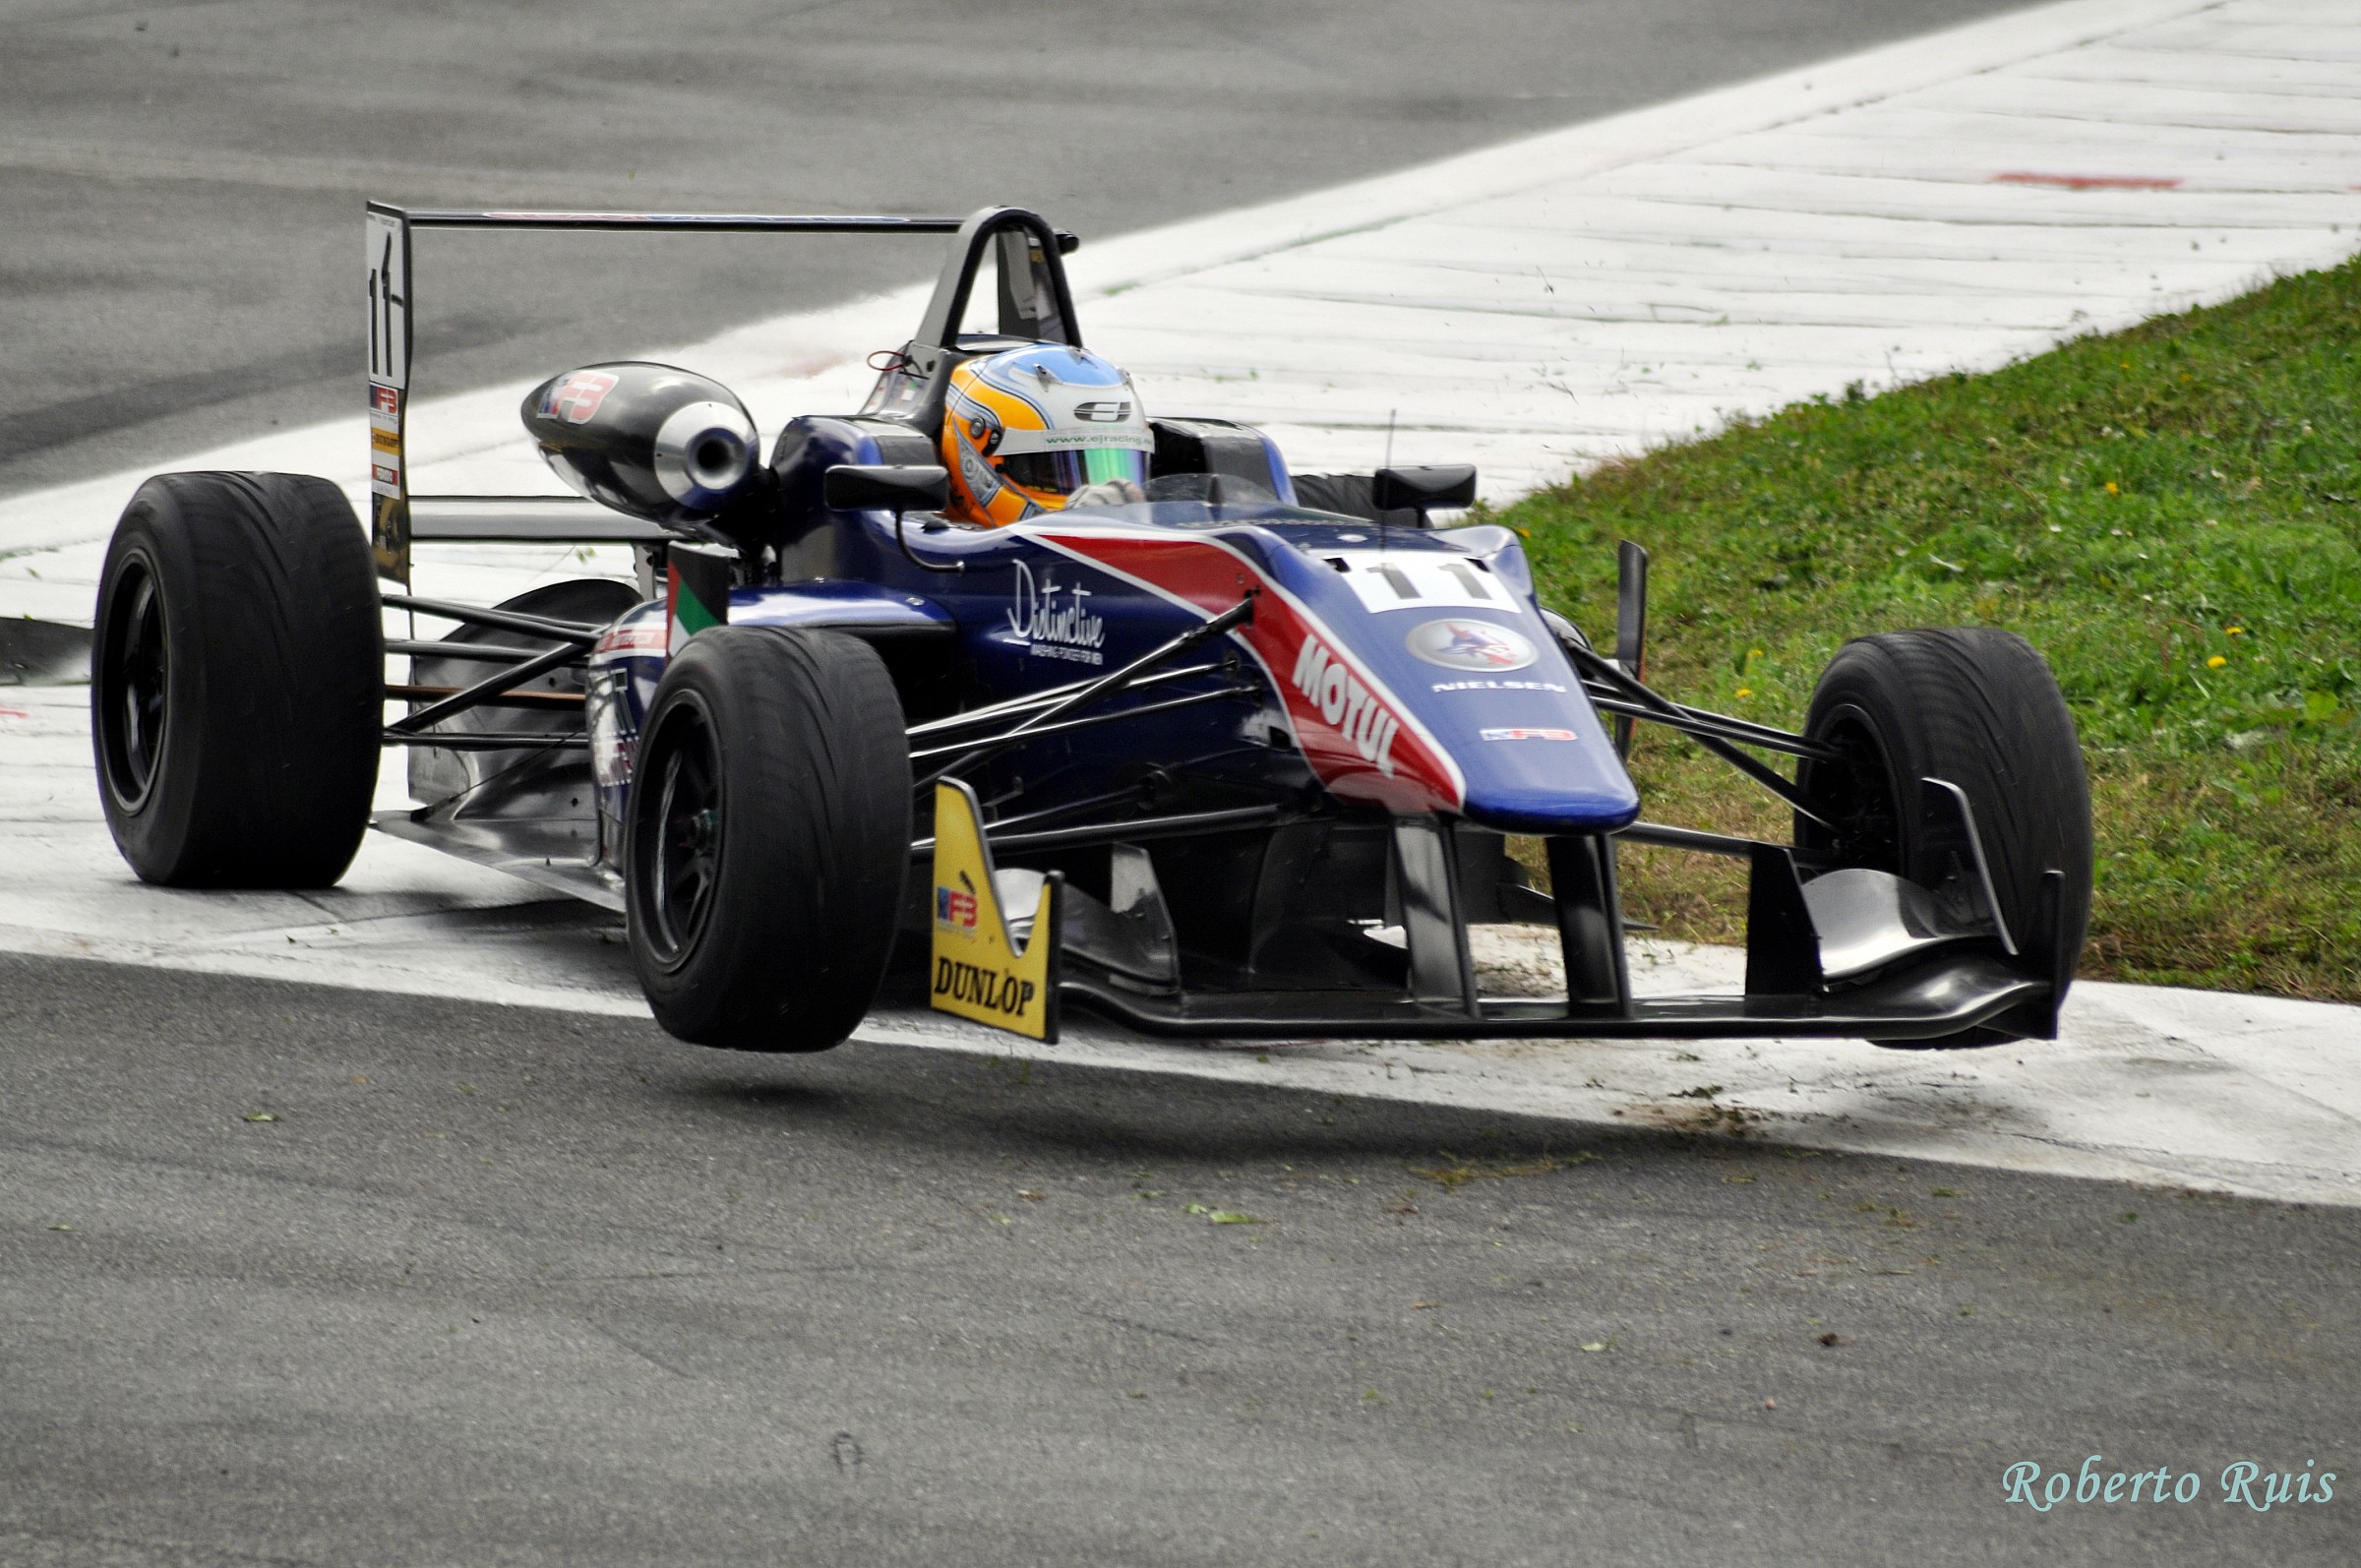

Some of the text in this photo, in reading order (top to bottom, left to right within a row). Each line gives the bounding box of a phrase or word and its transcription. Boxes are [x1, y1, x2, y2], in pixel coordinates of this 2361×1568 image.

[376, 386, 398, 414] F3
[549, 373, 617, 422] F3
[1005, 558, 1106, 649] Distinctive
[1365, 562, 1494, 601] 11
[1293, 633, 1400, 779] MOTUL
[1431, 681, 1567, 693] NIELSEN
[948, 890, 978, 928] F3
[935, 956, 1035, 1016] DUNLOP
